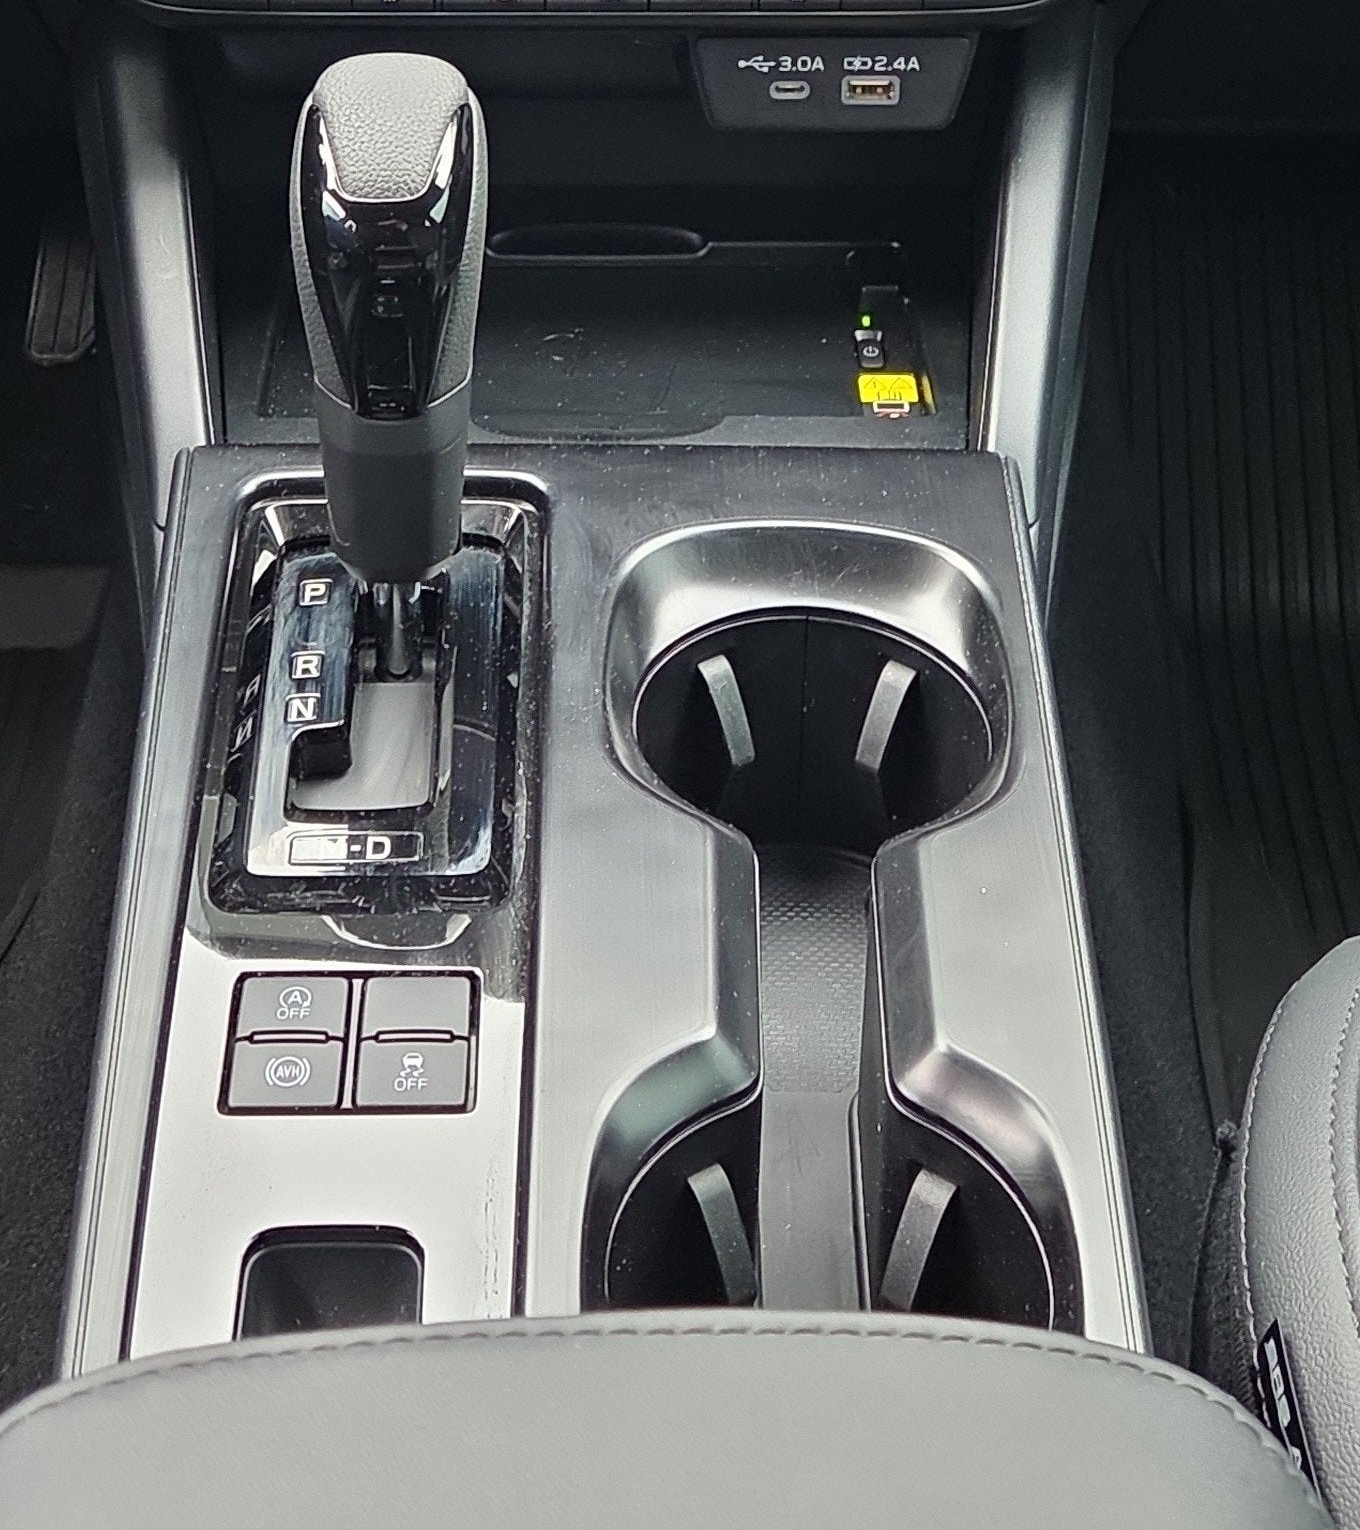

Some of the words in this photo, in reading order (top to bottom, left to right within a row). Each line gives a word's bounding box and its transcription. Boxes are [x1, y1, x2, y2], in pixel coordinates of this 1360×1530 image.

[777, 56, 825, 71] 3.0A
[873, 56, 920, 72] 2.4A
[303, 583, 327, 601] P
[295, 656, 320, 673] R
[290, 700, 317, 719] N
[276, 1008, 311, 1020] OFF
[275, 1064, 301, 1078] AVH
[394, 1078, 428, 1092] OFF
